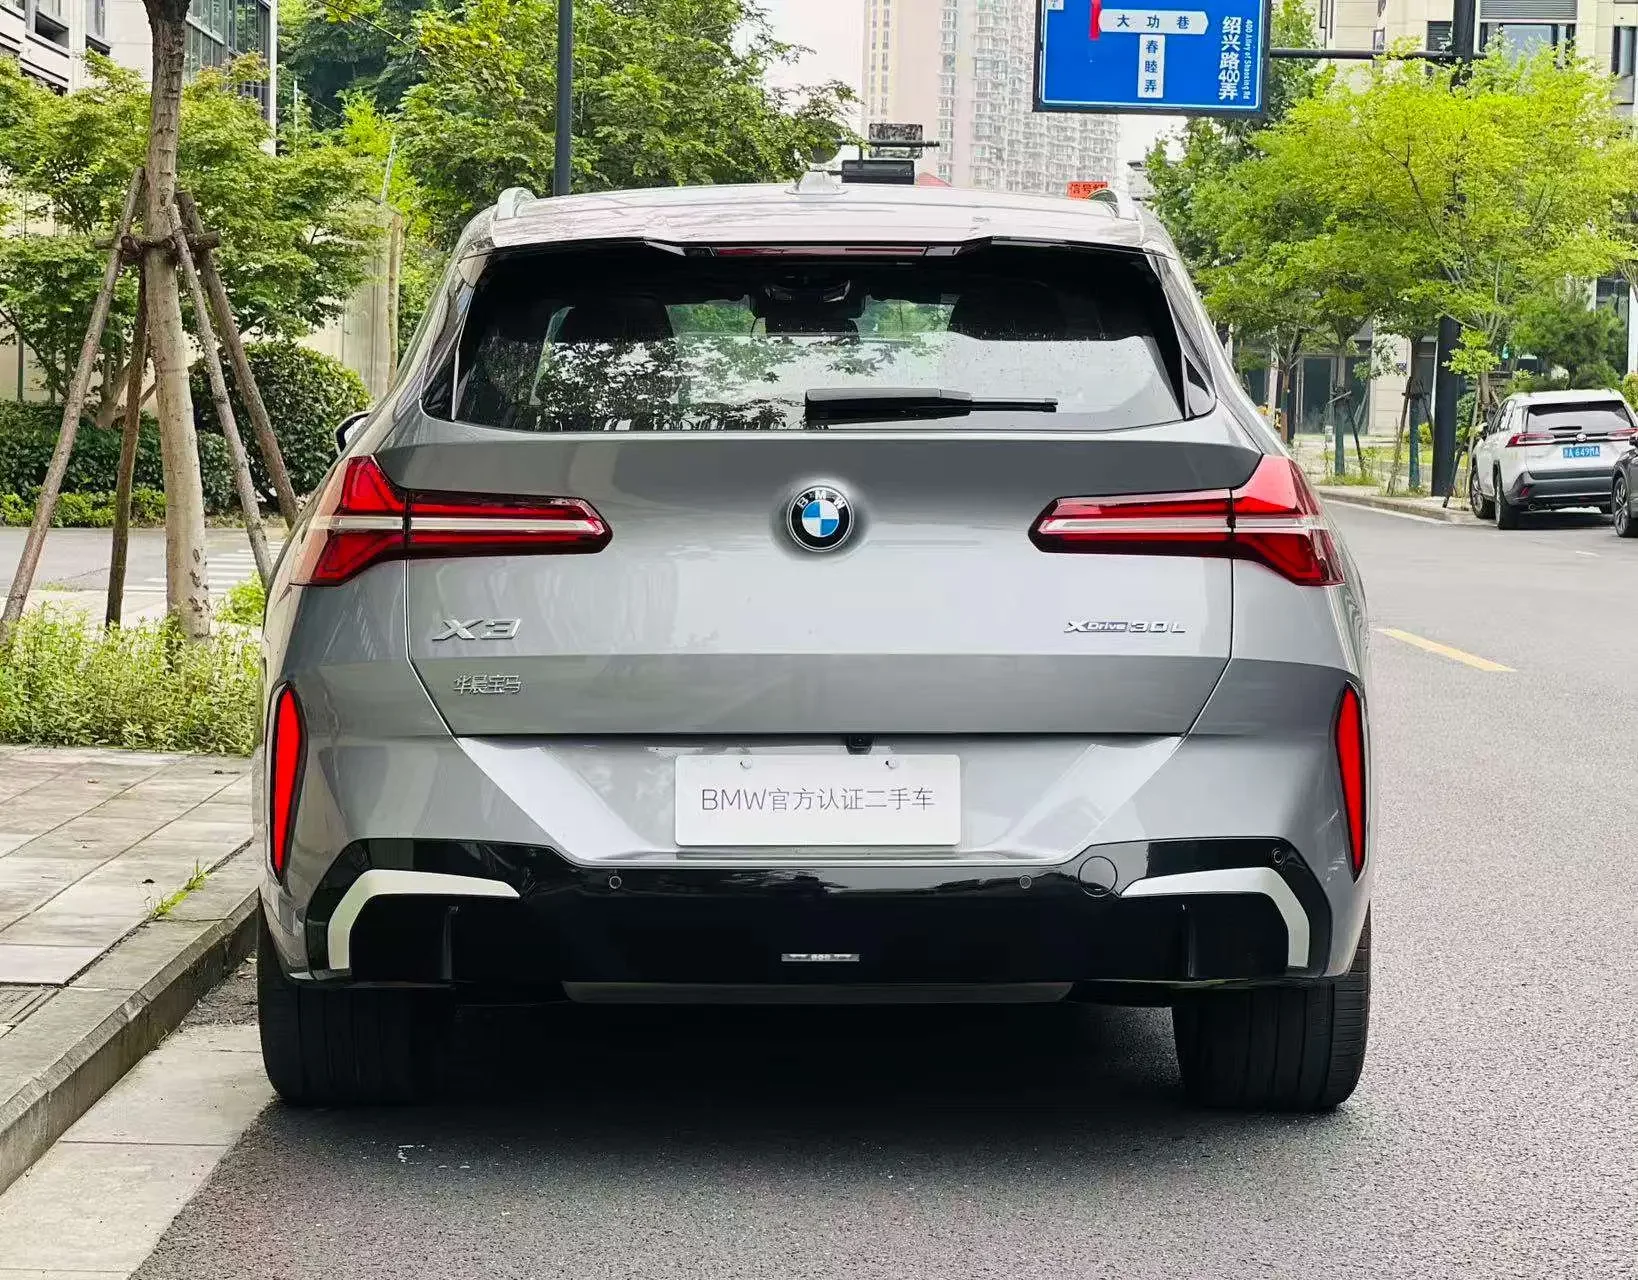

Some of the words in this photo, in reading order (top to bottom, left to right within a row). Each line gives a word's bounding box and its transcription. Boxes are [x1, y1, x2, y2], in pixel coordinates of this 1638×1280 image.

[1117, 14, 1190, 30] 大功巷
[1144, 39, 1160, 93] 春睦弄
[1218, 16, 1242, 101] 绍兴路400弄
[796, 489, 847, 510] BMW
[431, 618, 522, 641] X3
[453, 674, 522, 695] 华晨宝马
[701, 787, 936, 811] BMW官方认证二手车
